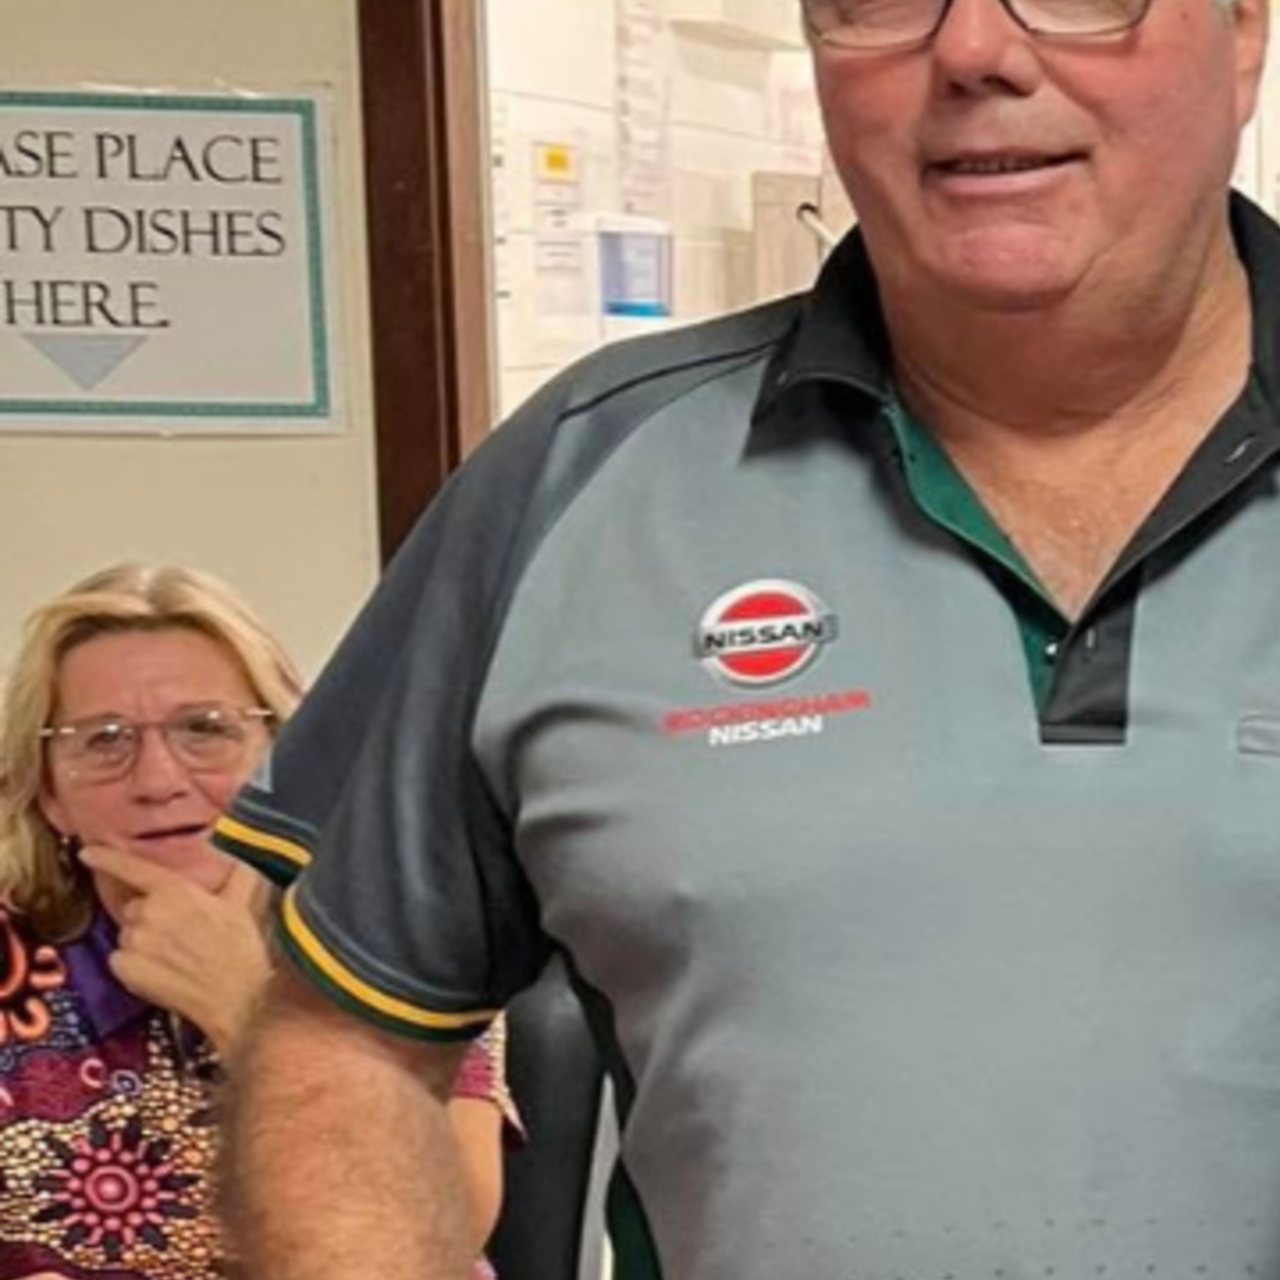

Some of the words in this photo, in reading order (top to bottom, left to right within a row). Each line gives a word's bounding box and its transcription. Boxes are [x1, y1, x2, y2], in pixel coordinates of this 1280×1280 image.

[95, 132, 282, 183] PLACE
[83, 206, 285, 256] DISHES
[705, 620, 823, 650] NISSAN
[708, 715, 823, 745] NISSAN
